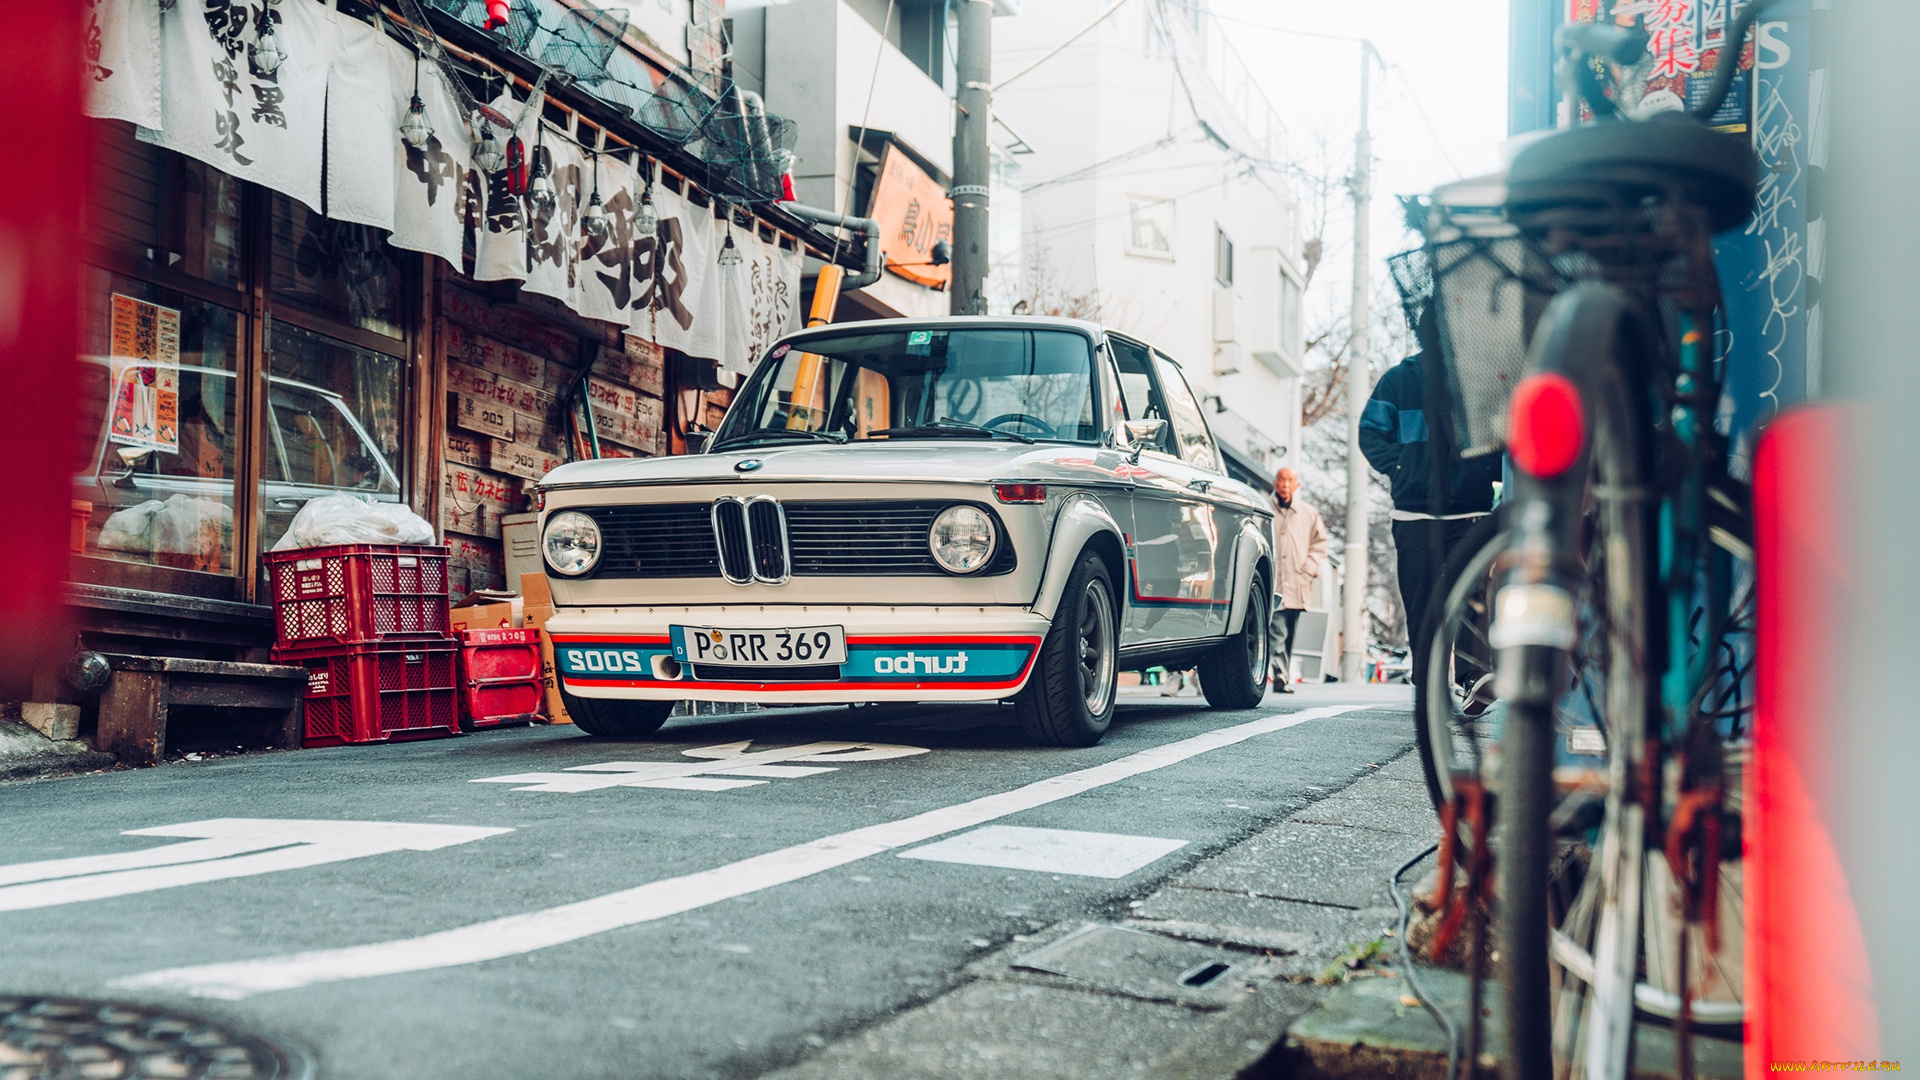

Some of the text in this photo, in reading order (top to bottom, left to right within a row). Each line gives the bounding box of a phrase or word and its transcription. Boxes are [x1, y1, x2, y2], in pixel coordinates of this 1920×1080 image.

[676, 646, 684, 655] D
[694, 631, 831, 662] P RR 369
